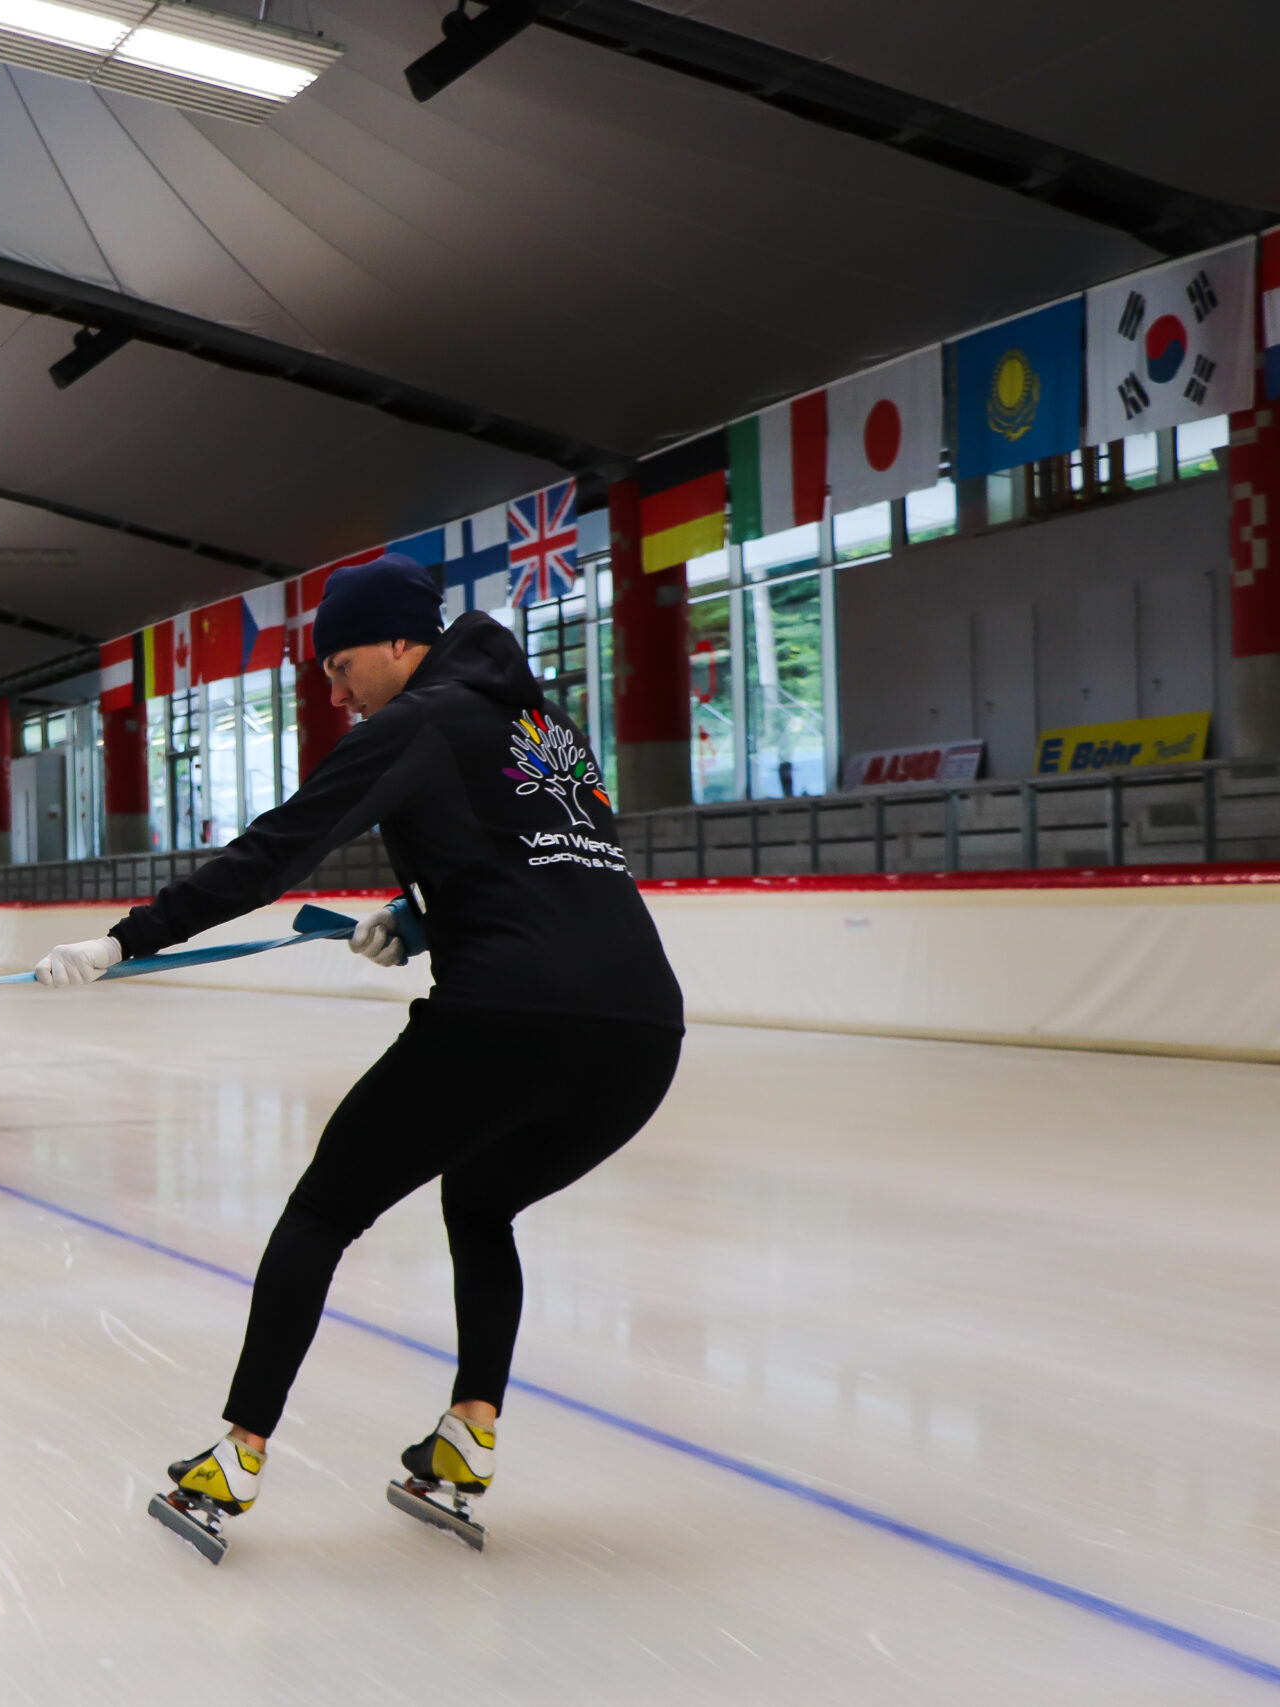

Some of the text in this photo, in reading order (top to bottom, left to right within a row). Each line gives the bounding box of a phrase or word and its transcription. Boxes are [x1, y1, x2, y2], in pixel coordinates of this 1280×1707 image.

[1070, 739, 1142, 770] Böhr
[519, 832, 628, 863] Van Wersc
[528, 852, 592, 868] coaching
